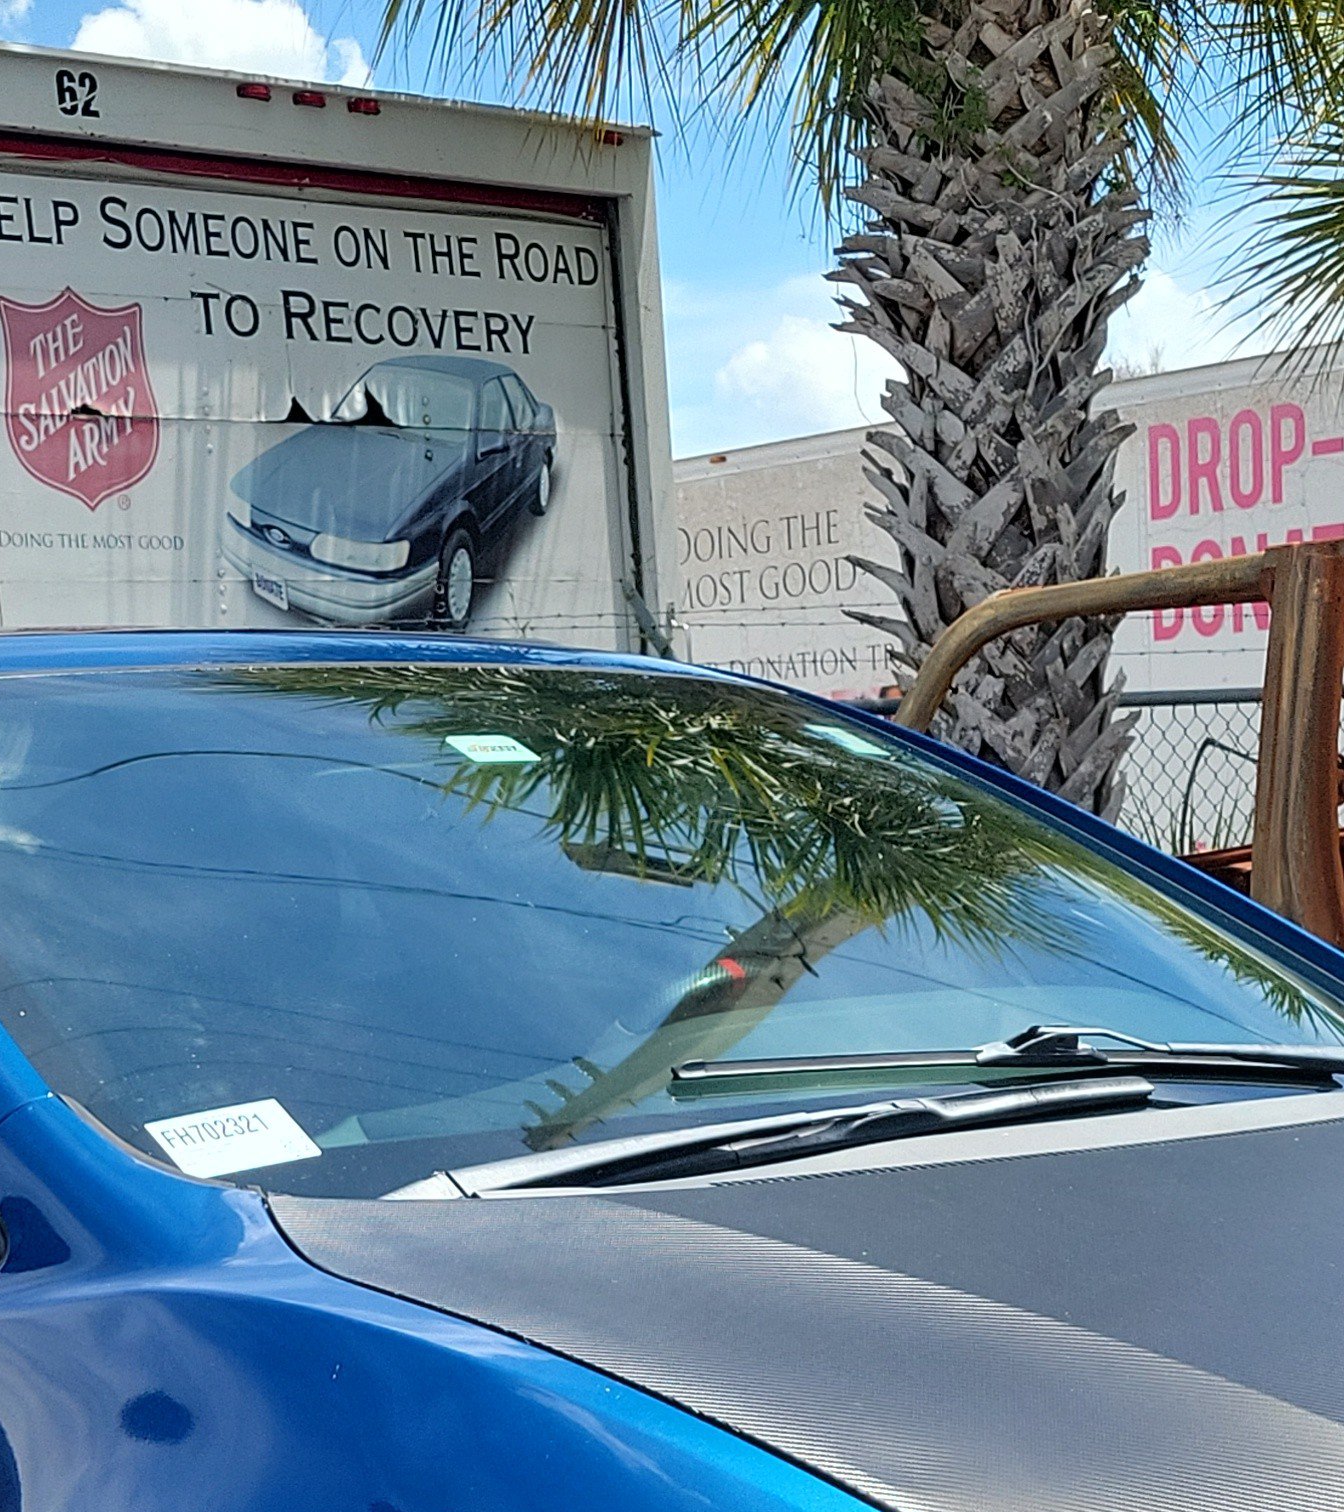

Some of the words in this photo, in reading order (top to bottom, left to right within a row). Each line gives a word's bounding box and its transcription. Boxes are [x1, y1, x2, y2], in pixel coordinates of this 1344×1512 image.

[56, 69, 100, 118] 62
[100, 196, 318, 265] SOMEONE
[333, 225, 390, 270] ON
[403, 230, 481, 278] THE
[494, 232, 599, 286] ROAD
[30, 313, 84, 379] THE
[191, 291, 259, 337] TO
[280, 289, 534, 354] RECOVERY
[18, 325, 136, 451] SALVATION
[68, 387, 136, 481] ARMY
[58, 533, 89, 549] THE
[93, 534, 133, 550] MOST
[138, 535, 185, 551] GOOD
[780, 509, 839, 550] THE
[759, 557, 857, 600] GOOD
[161, 1112, 270, 1149] FH702321
